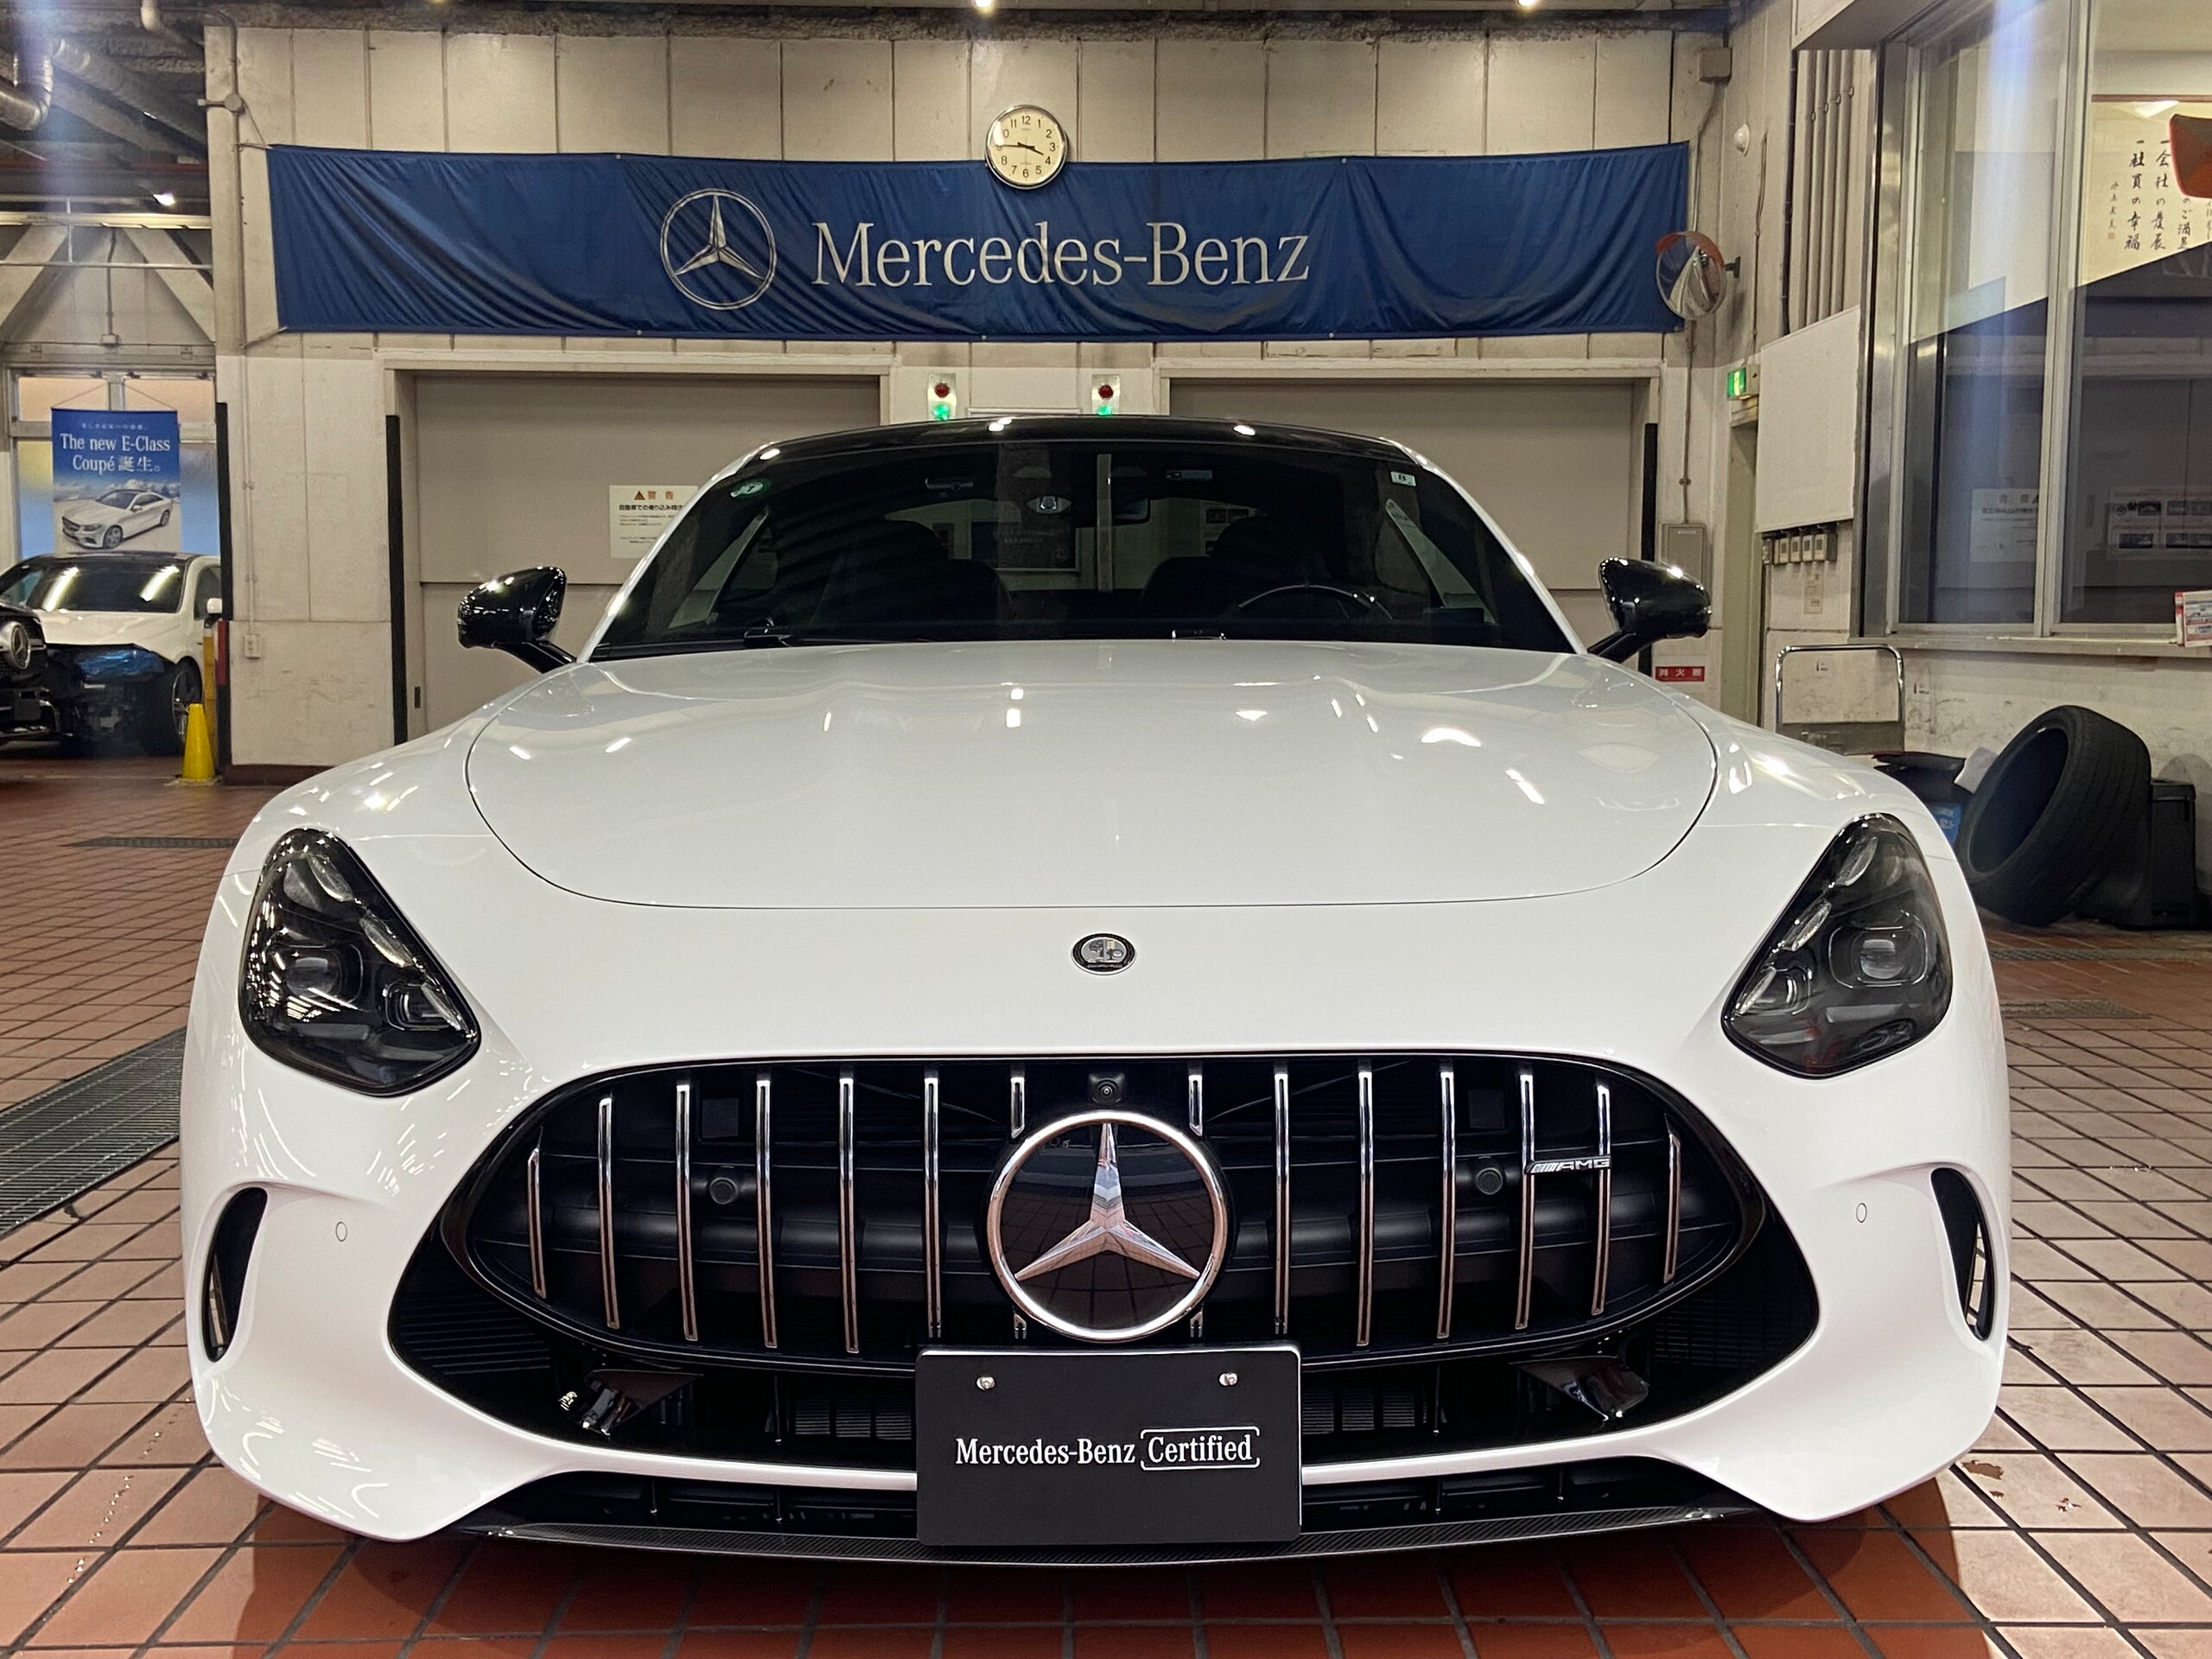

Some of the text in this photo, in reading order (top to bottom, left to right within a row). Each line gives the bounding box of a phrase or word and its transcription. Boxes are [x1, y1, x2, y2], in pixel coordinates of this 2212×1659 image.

[1010, 118, 1017, 128] 11
[1021, 115, 1031, 125] 12
[1046, 129, 1052, 138] 2
[1049, 142, 1056, 152] 3
[1001, 156, 1007, 165] 8
[1045, 156, 1052, 165] 4
[1011, 165, 1018, 175] 7
[1022, 168, 1029, 178] 6
[1035, 165, 1042, 175] 5
[811, 220, 1310, 288] Mercedes-Benz
[60, 433, 170, 452] The new E-Class
[73, 454, 115, 475] Coupé
[1556, 1158, 1611, 1172] AMG
[956, 1434, 1253, 1465] Mercedes-Benz Certified
